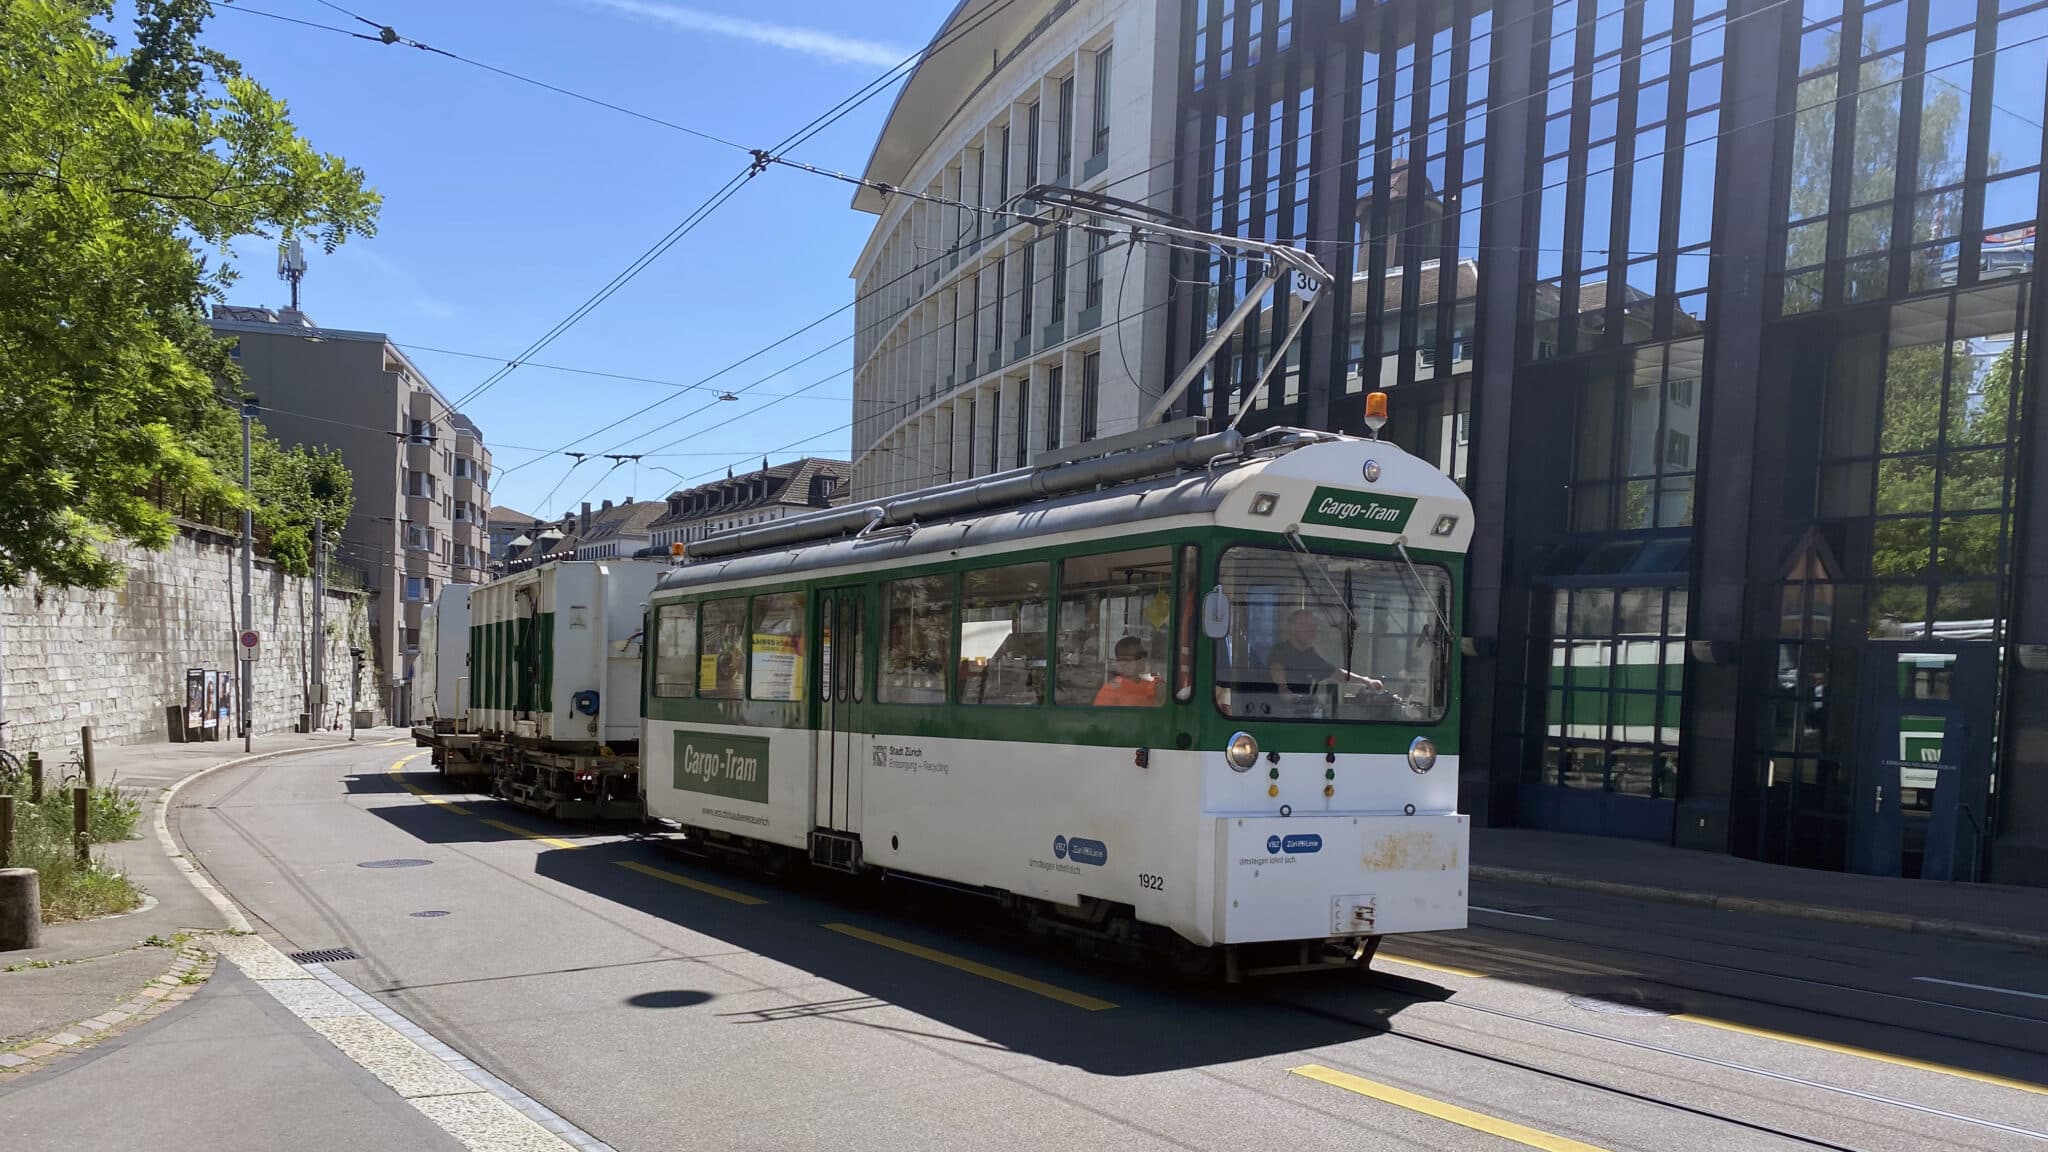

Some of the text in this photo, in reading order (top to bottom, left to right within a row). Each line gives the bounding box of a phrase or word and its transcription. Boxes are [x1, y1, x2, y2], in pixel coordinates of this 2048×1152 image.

[1318, 497, 1400, 522] Cargo-Tram
[684, 744, 757, 782] Cargo-Tram
[1138, 872, 1163, 891] 1922
